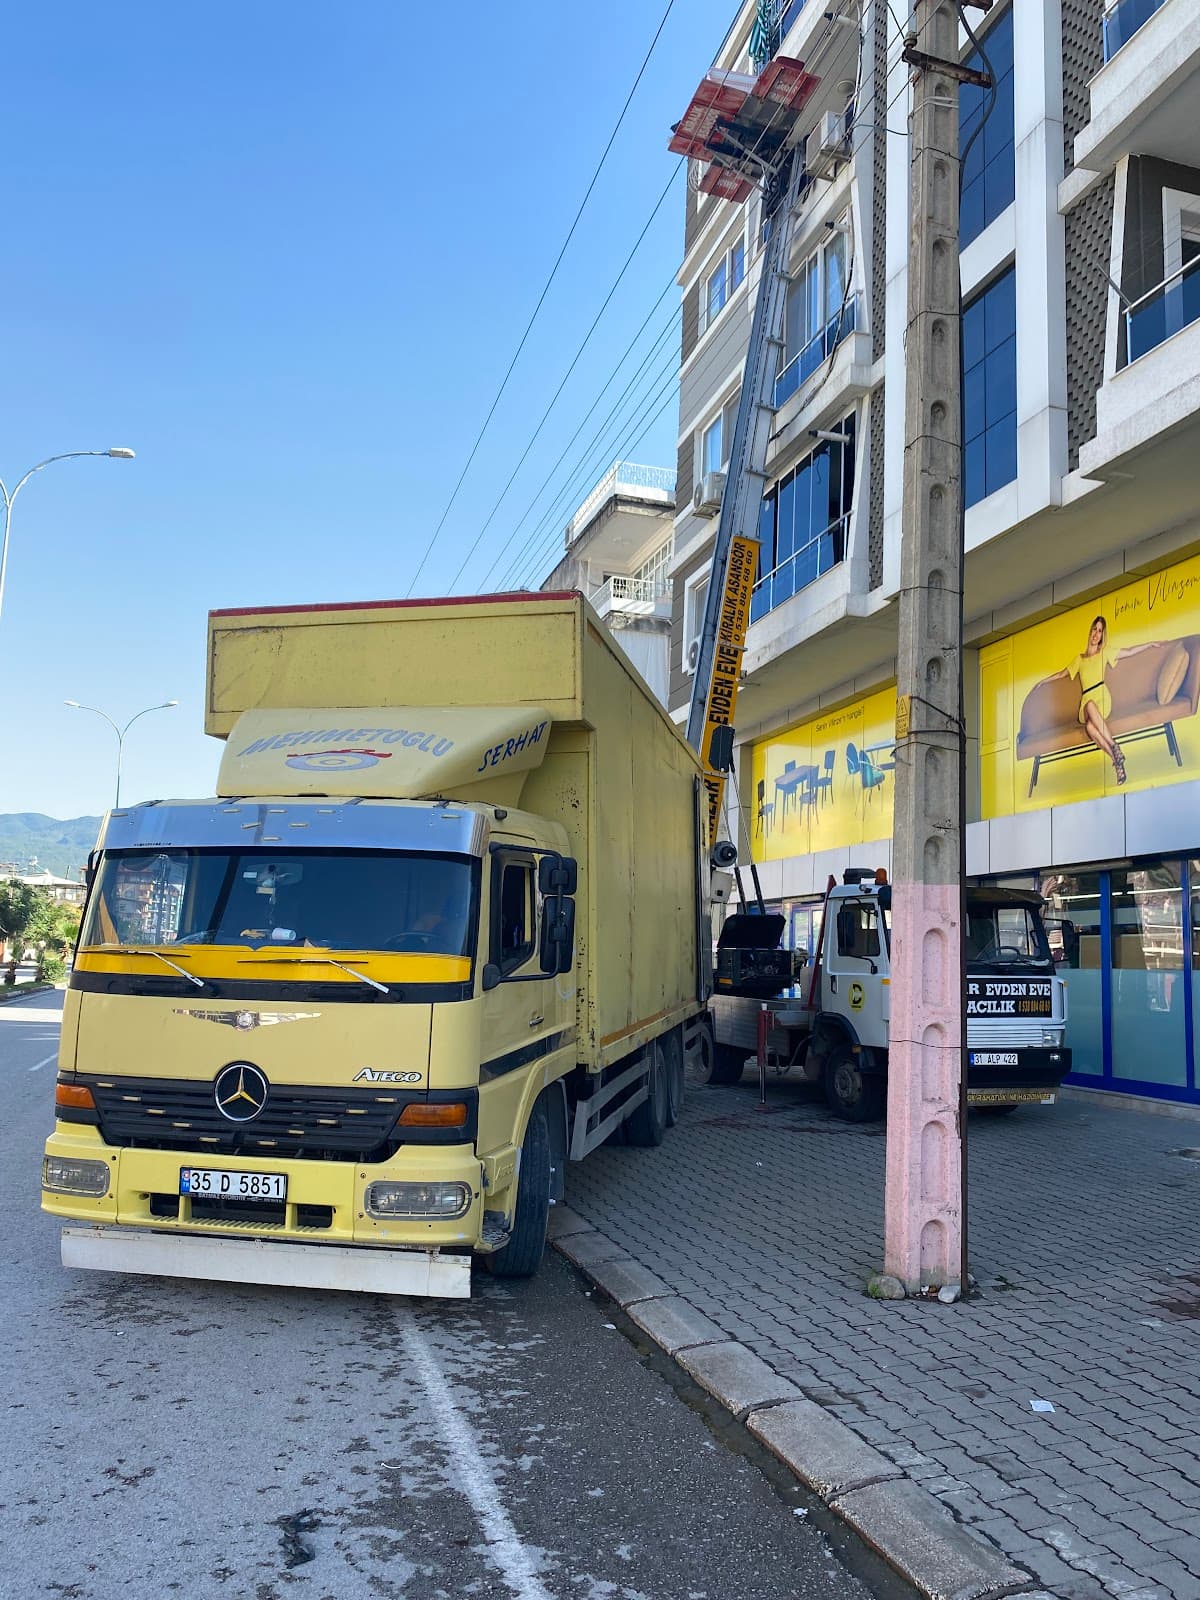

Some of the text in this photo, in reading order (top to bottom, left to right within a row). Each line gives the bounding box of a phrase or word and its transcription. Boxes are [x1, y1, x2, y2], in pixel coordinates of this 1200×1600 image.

[720, 542, 746, 645] KİRALIK ASANSÖR
[734, 550, 753, 642] 0 538 884 68 60
[708, 646, 738, 725] EVDEN EVE
[477, 721, 547, 772] SERHAT
[966, 983, 1051, 996] R EVDEN EVE
[966, 1000, 1016, 1013] ACILIK
[975, 1054, 983, 1064] 31
[987, 1054, 1001, 1064] ALP
[352, 1067, 422, 1083] ATEGO
[191, 1172, 281, 1196] 35 D 5851
